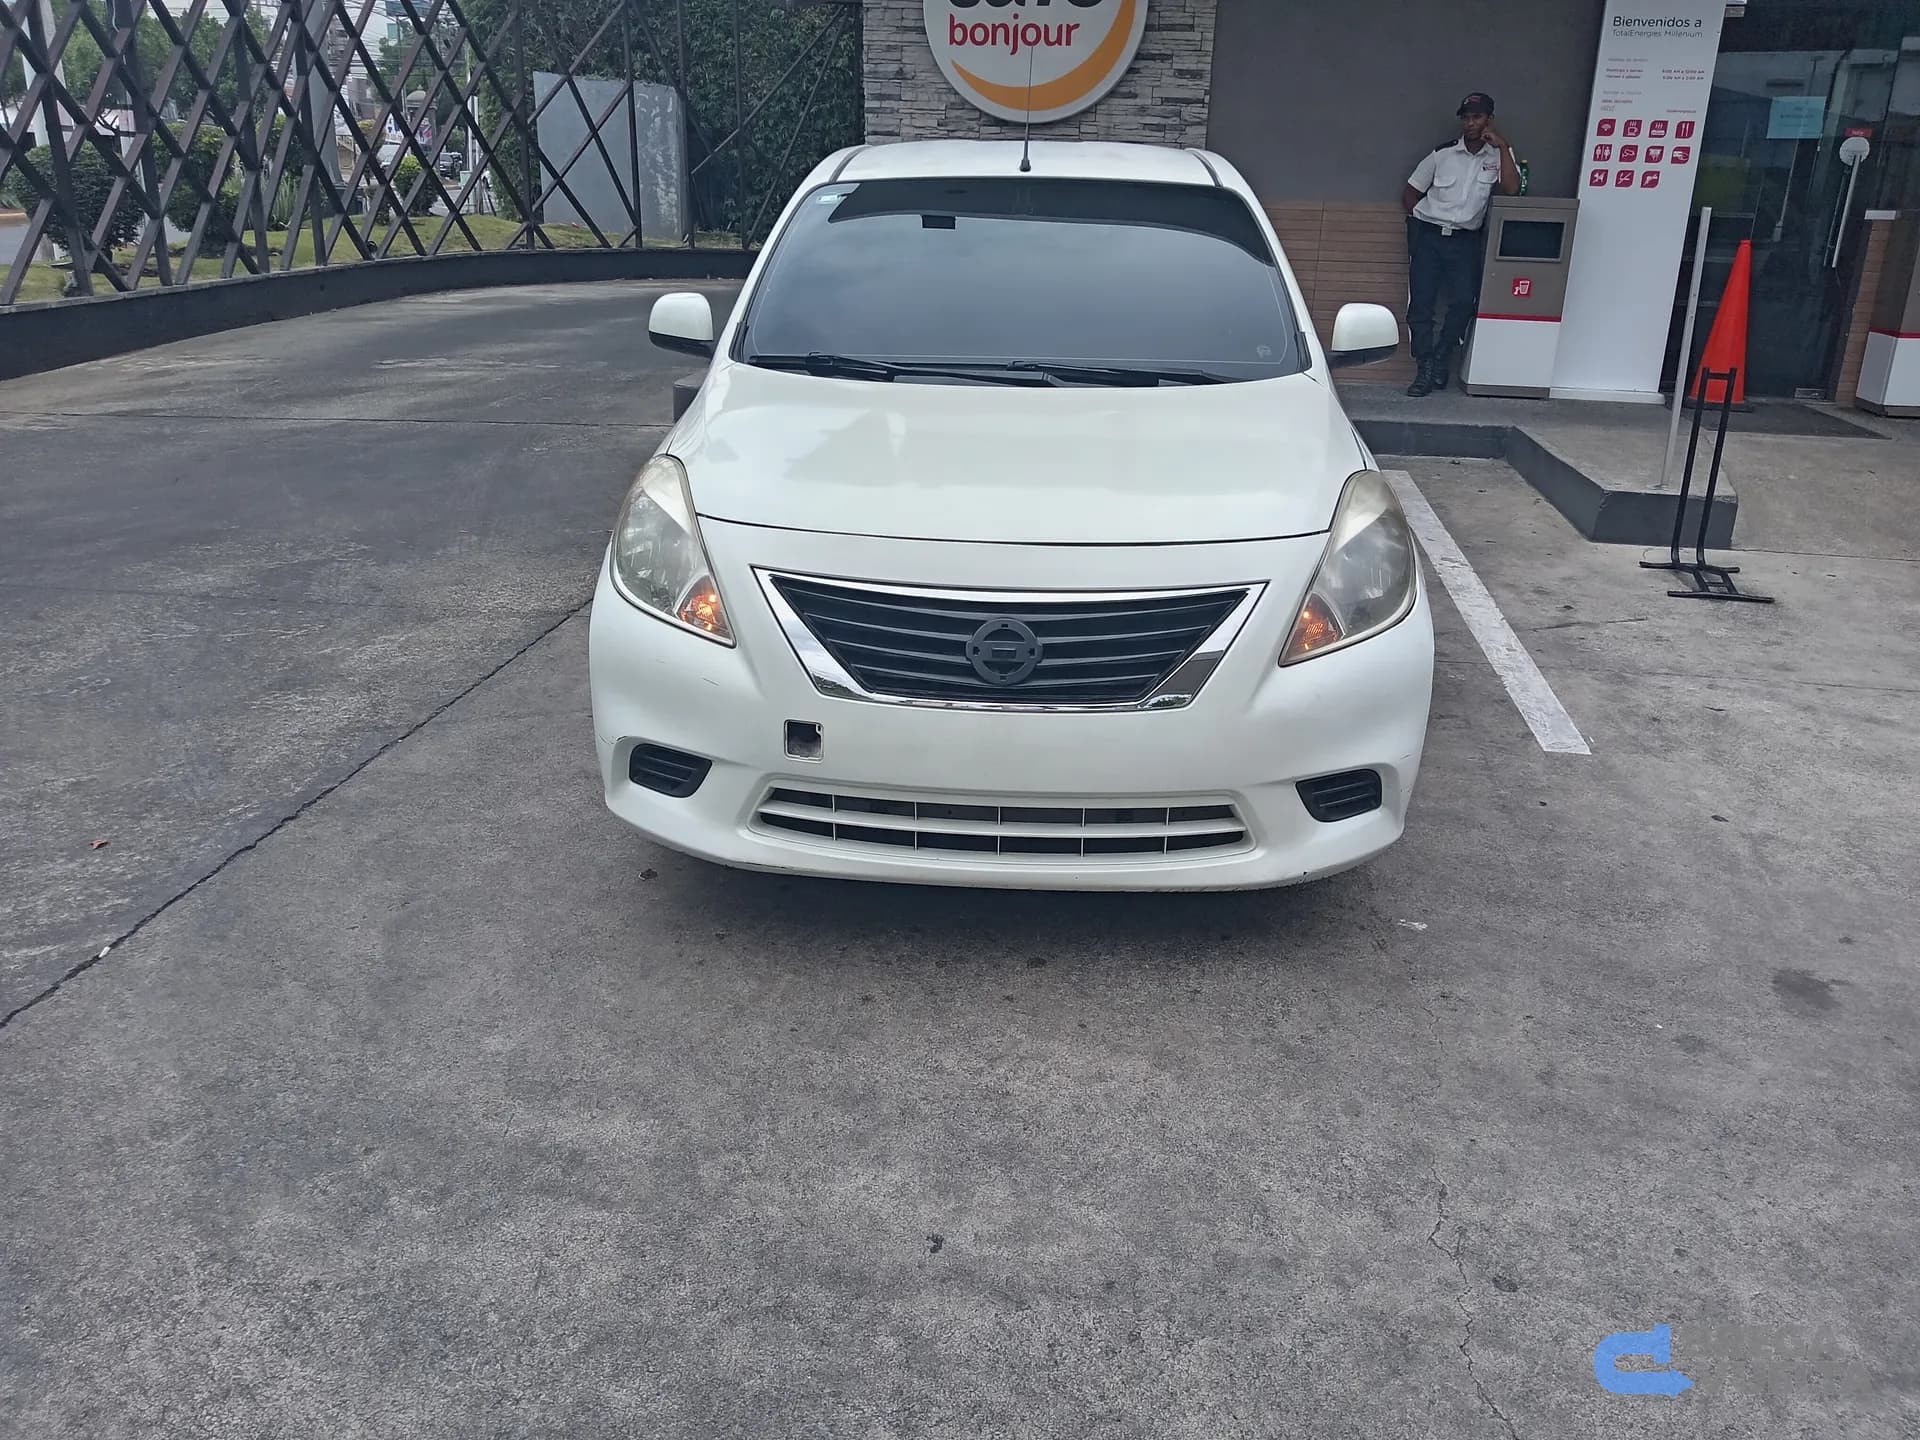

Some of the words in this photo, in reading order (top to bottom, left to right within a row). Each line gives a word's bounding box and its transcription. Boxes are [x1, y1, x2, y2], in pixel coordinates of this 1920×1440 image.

[949, 13, 1081, 56] bonjour
[1613, 16, 1690, 27] Bienvenidos
[1694, 19, 1702, 27] a
